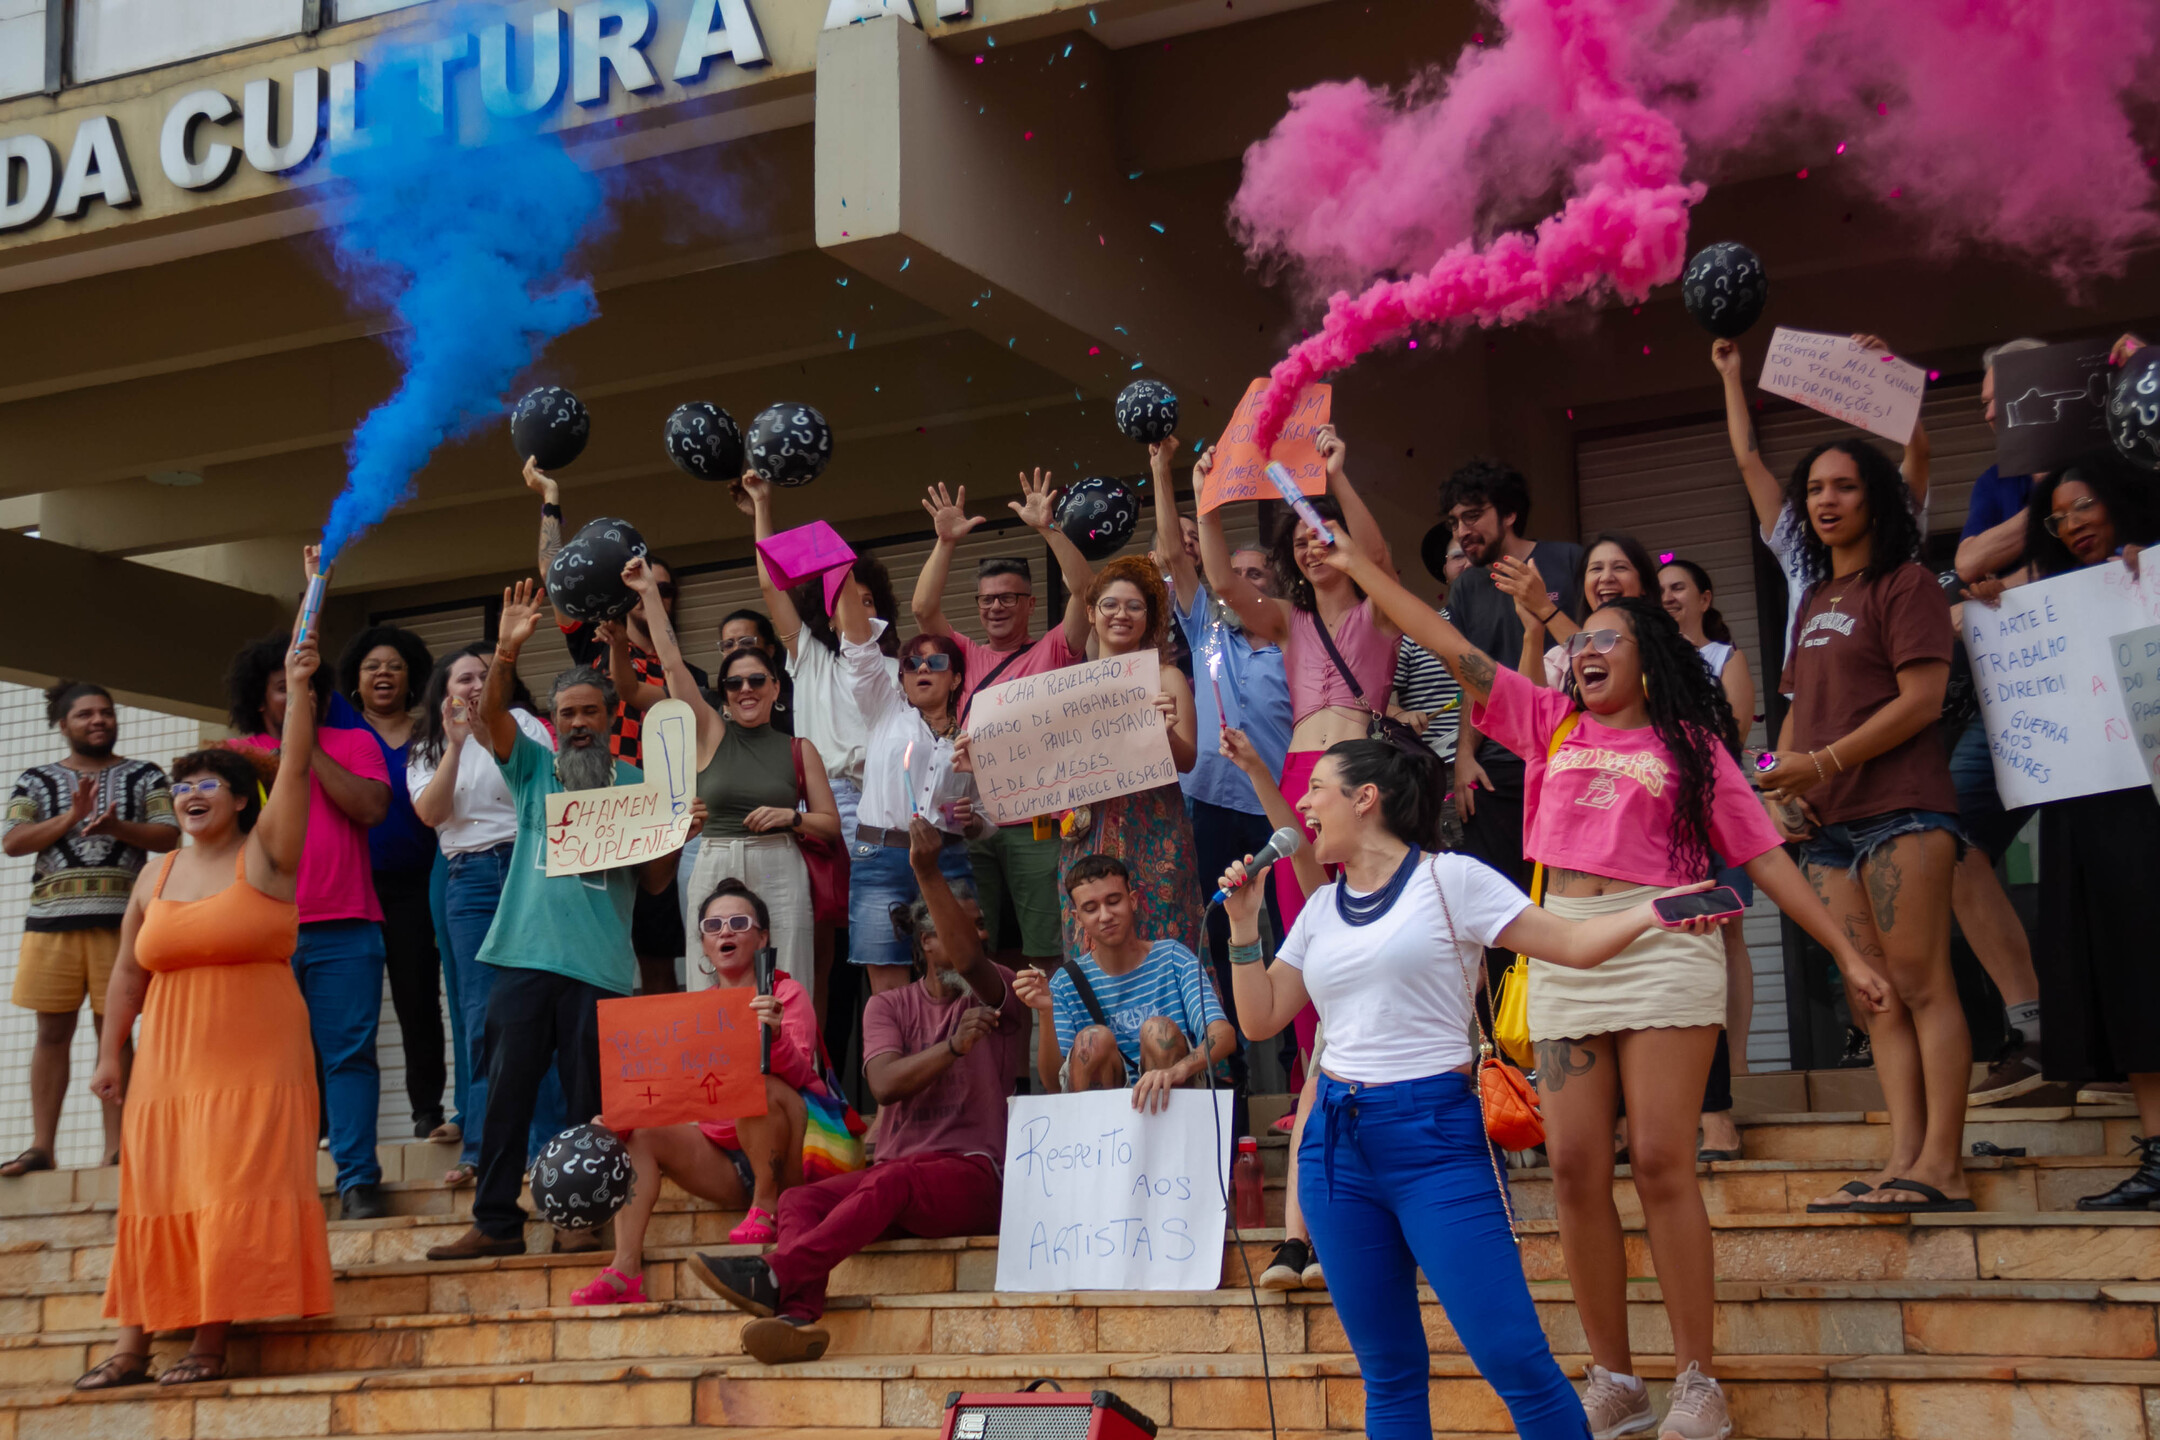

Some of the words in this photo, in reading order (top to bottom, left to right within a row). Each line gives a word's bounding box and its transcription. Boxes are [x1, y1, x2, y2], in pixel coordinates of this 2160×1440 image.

[0, 115, 142, 234] DA
[160, 0, 772, 192] CULTURA
[1771, 354, 1792, 367] DO
[1841, 359, 1877, 378] MAL
[1973, 626, 1983, 643] A
[2000, 609, 2041, 637] ARTE
[2045, 595, 2059, 623] É
[1975, 635, 2067, 677] TRABALHO
[1005, 676, 1036, 704] CHÁ
[1043, 659, 1122, 696] REVELAÇÃO
[972, 719, 1022, 744] ATRASO
[1032, 712, 1053, 728] DE
[1062, 686, 1147, 717] PAGAMENTO
[2011, 710, 2069, 745] GUERRA
[977, 752, 997, 770] DA
[1041, 729, 1082, 756] PAULO
[1091, 708, 1157, 740] GUSTAVO!
[2001, 729, 2032, 749] AOS
[998, 802, 1007, 820] A
[1067, 779, 1112, 802] MERECE
[1006, 775, 1026, 792] DE
[1036, 766, 1046, 786] 6
[557, 816, 690, 868] SUPLENTES
[595, 823, 616, 838] OS
[606, 1007, 736, 1061] REVELA
[621, 1056, 668, 1079] MAIS
[1132, 1174, 1191, 1200] AOS
